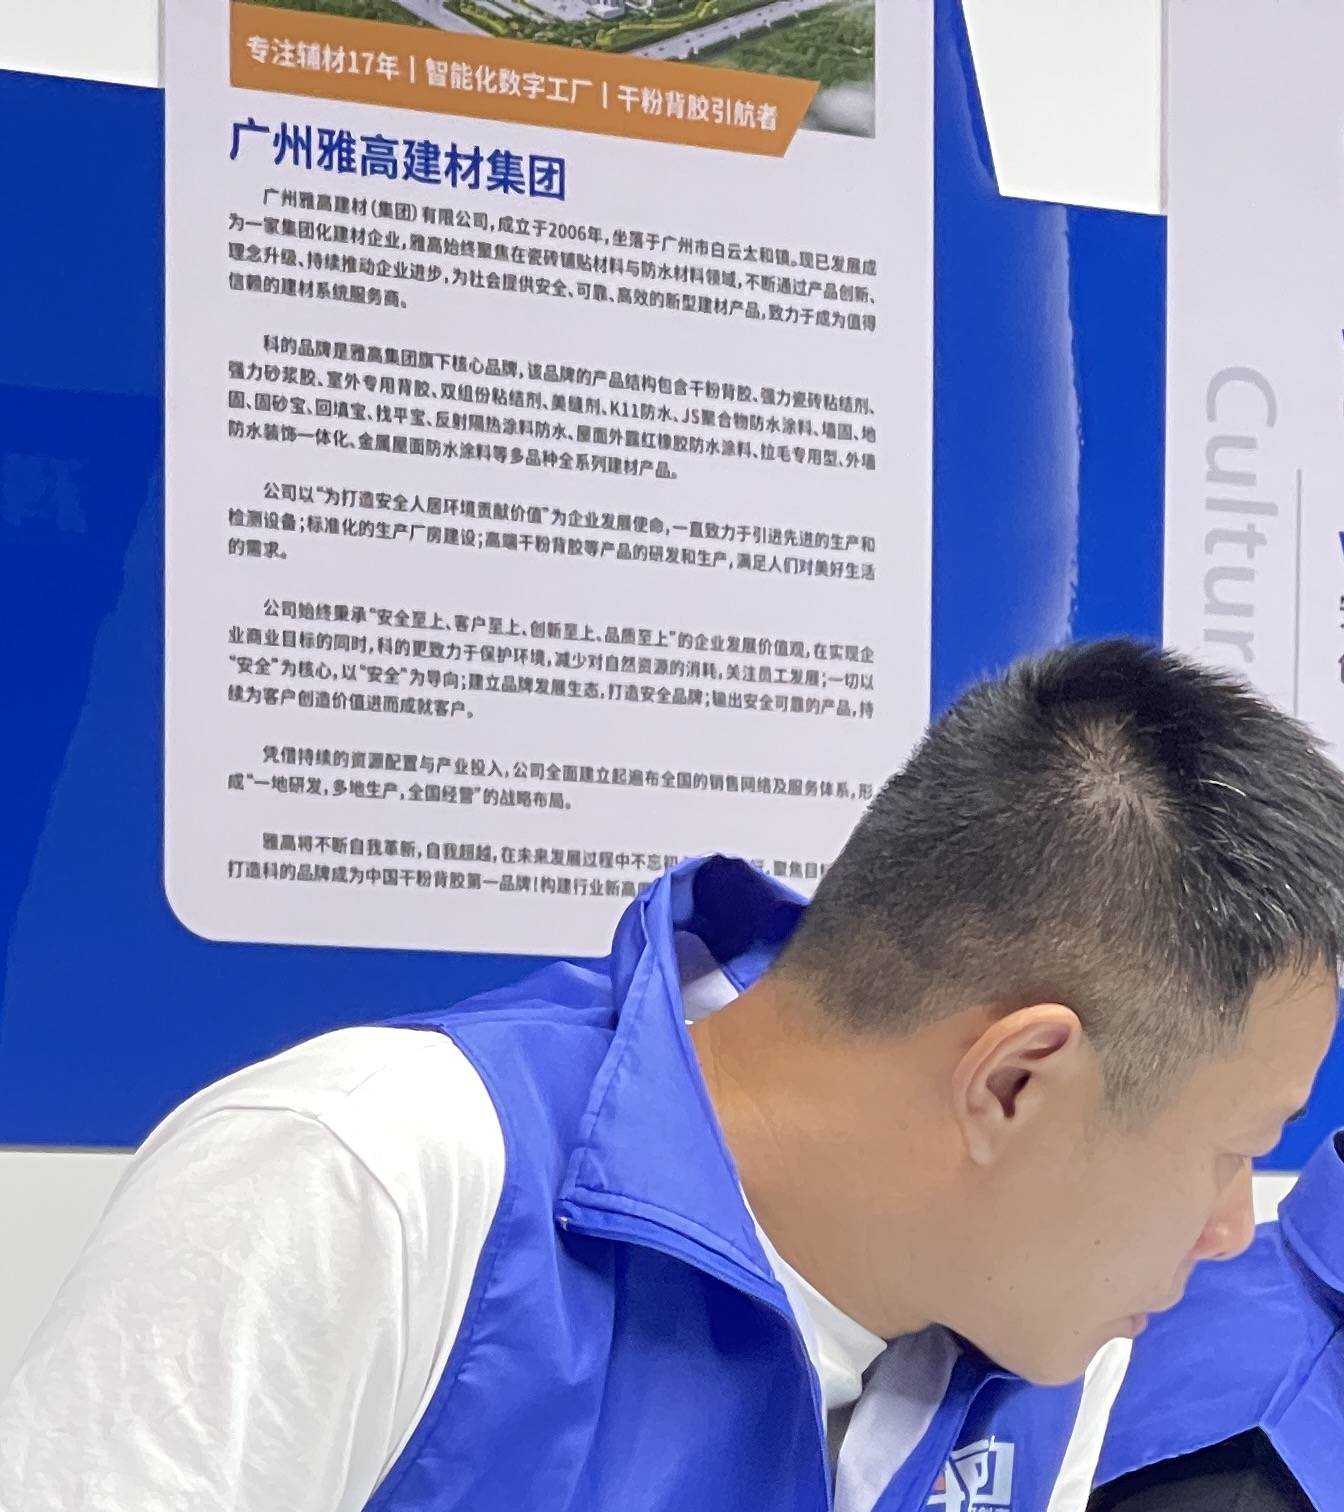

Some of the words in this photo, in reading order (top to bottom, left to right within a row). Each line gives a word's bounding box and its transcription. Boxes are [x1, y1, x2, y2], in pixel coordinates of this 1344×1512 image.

[246, 36, 401, 82] 专注辅材17年
[424, 56, 594, 107] 智能化数字工厂
[615, 83, 778, 132] 干粉背胶引航者
[229, 119, 567, 201] 广州雅高建材集团
[1203, 366, 1279, 662] Cultur
